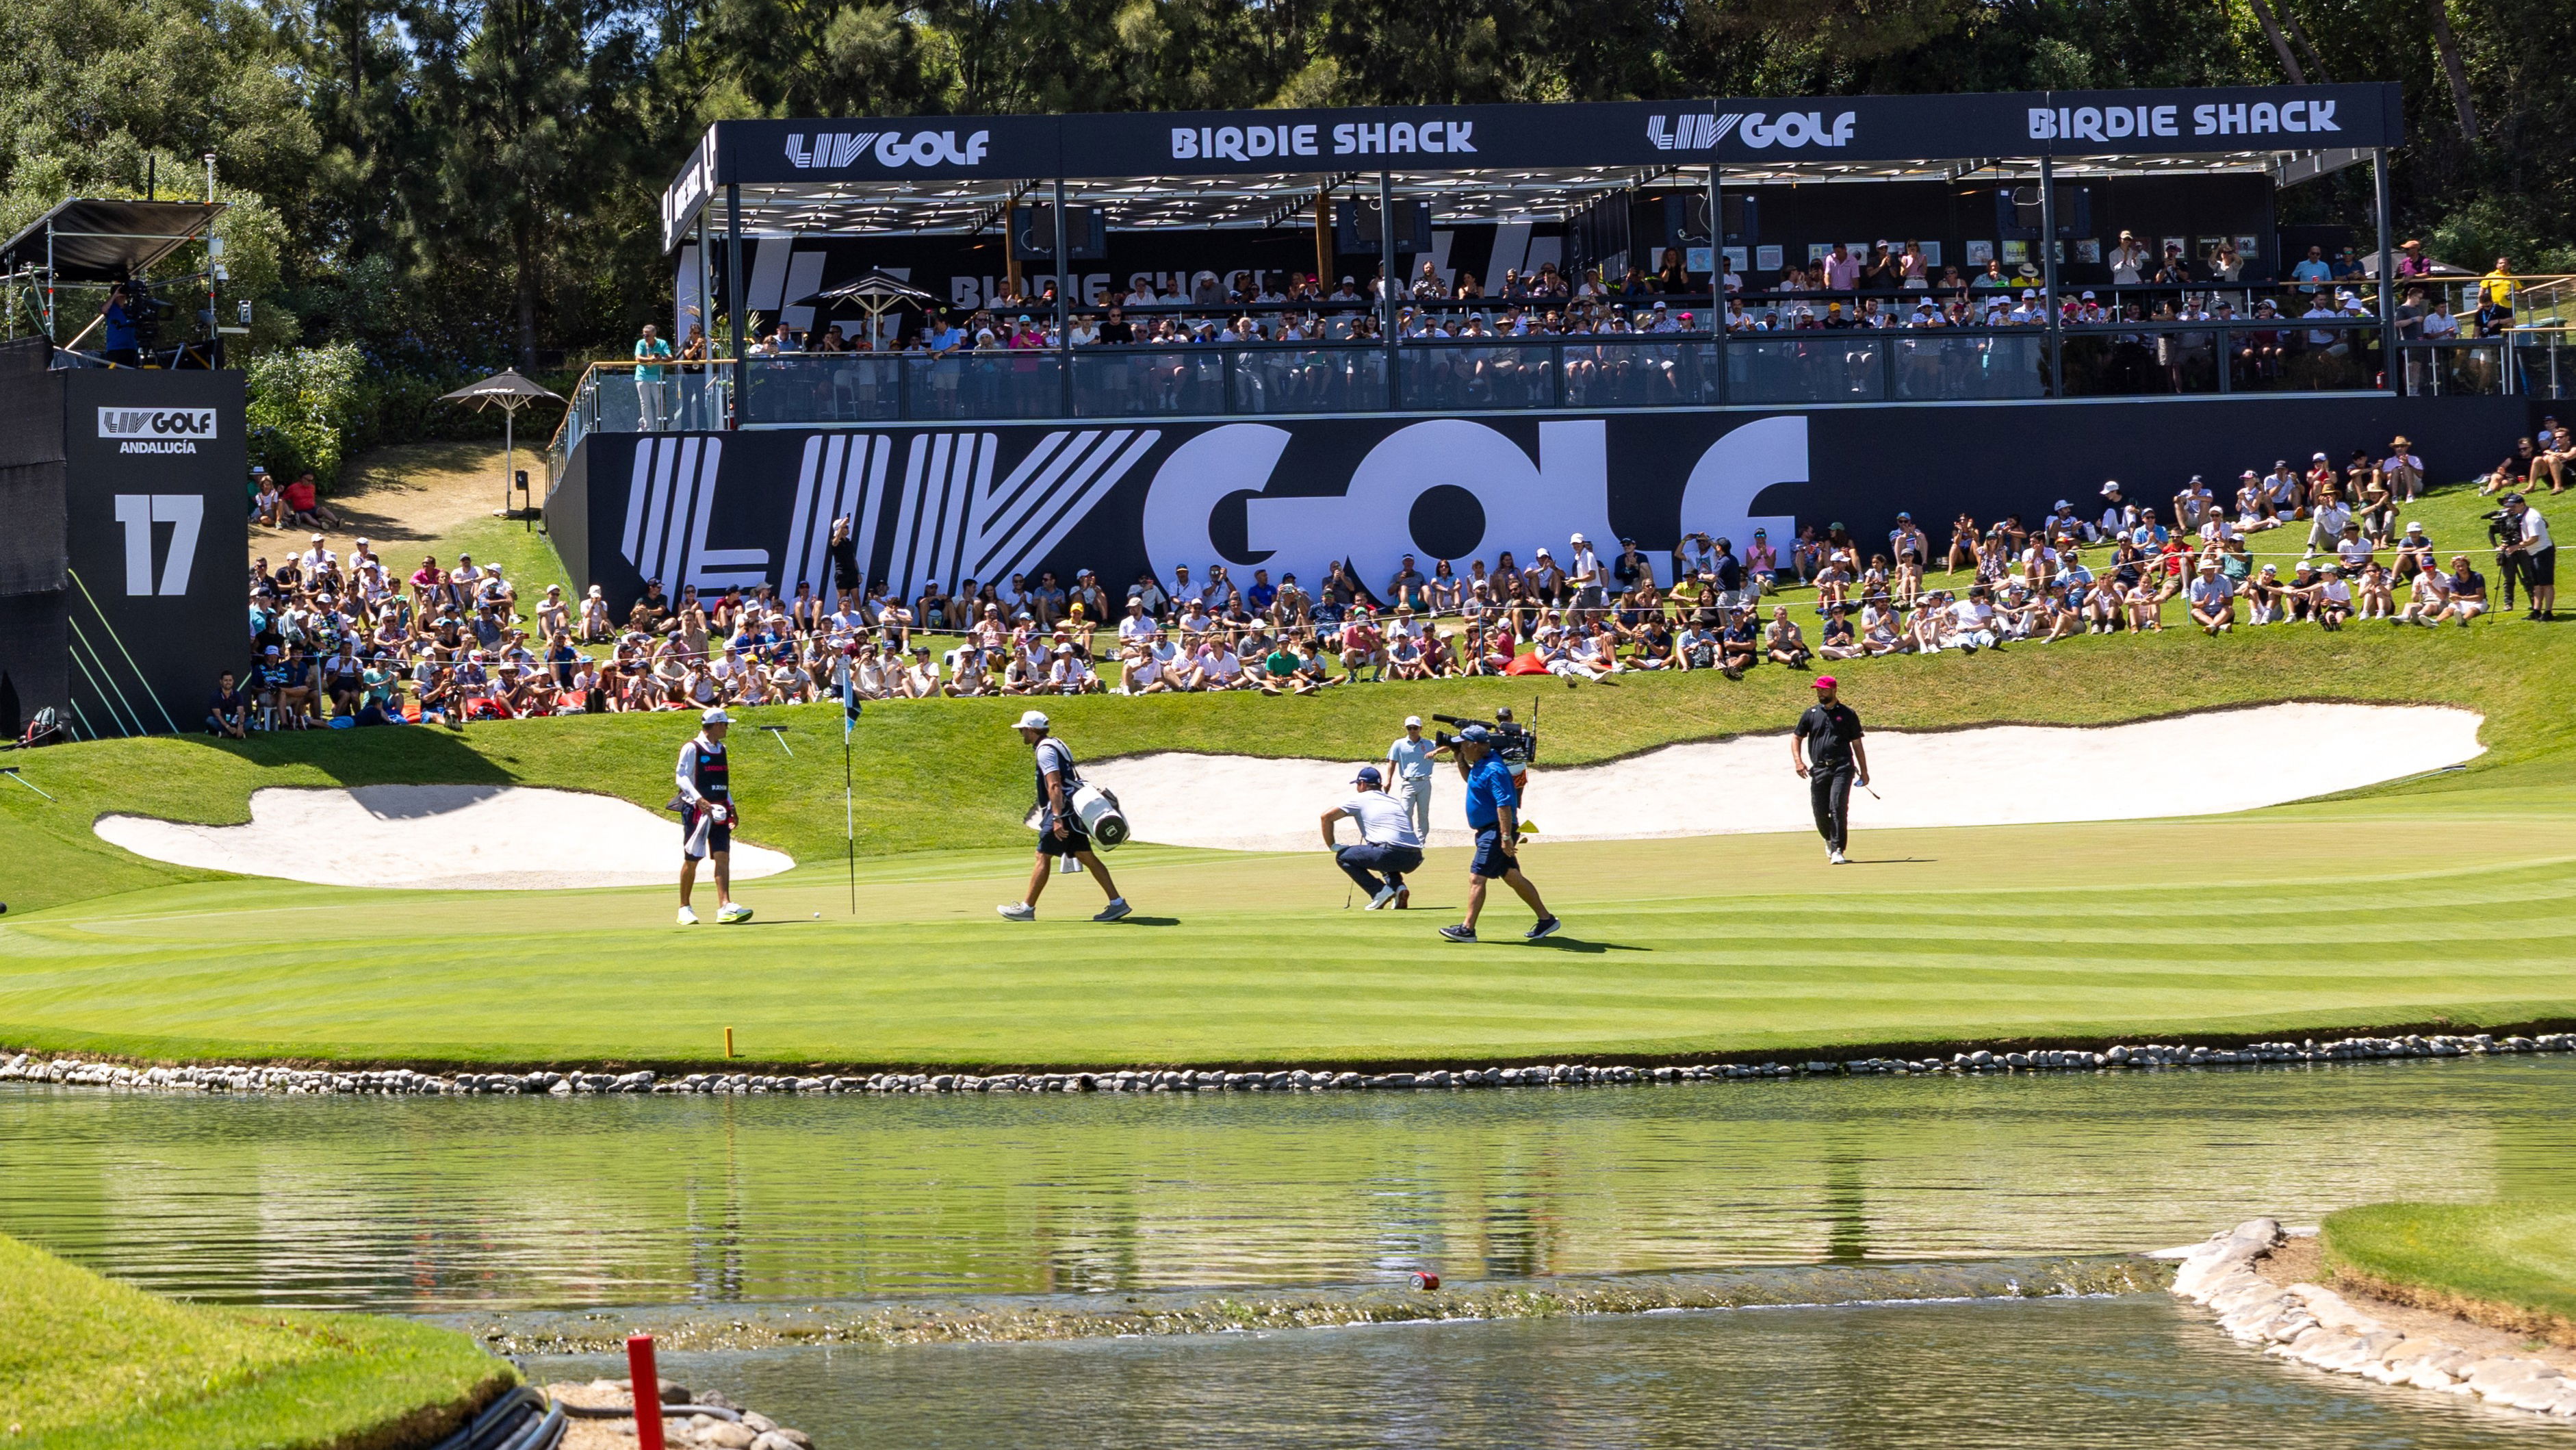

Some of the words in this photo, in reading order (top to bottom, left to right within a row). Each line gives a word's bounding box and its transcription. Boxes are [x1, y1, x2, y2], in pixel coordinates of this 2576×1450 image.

[2028, 106, 2178, 141] BIRDIE
[2194, 101, 2341, 134] SHACK
[1172, 125, 1317, 161] BIRDIE
[1334, 122, 1477, 153] SHACK
[120, 440, 196, 454] ANDALUCÍA
[115, 495, 203, 596] 17
